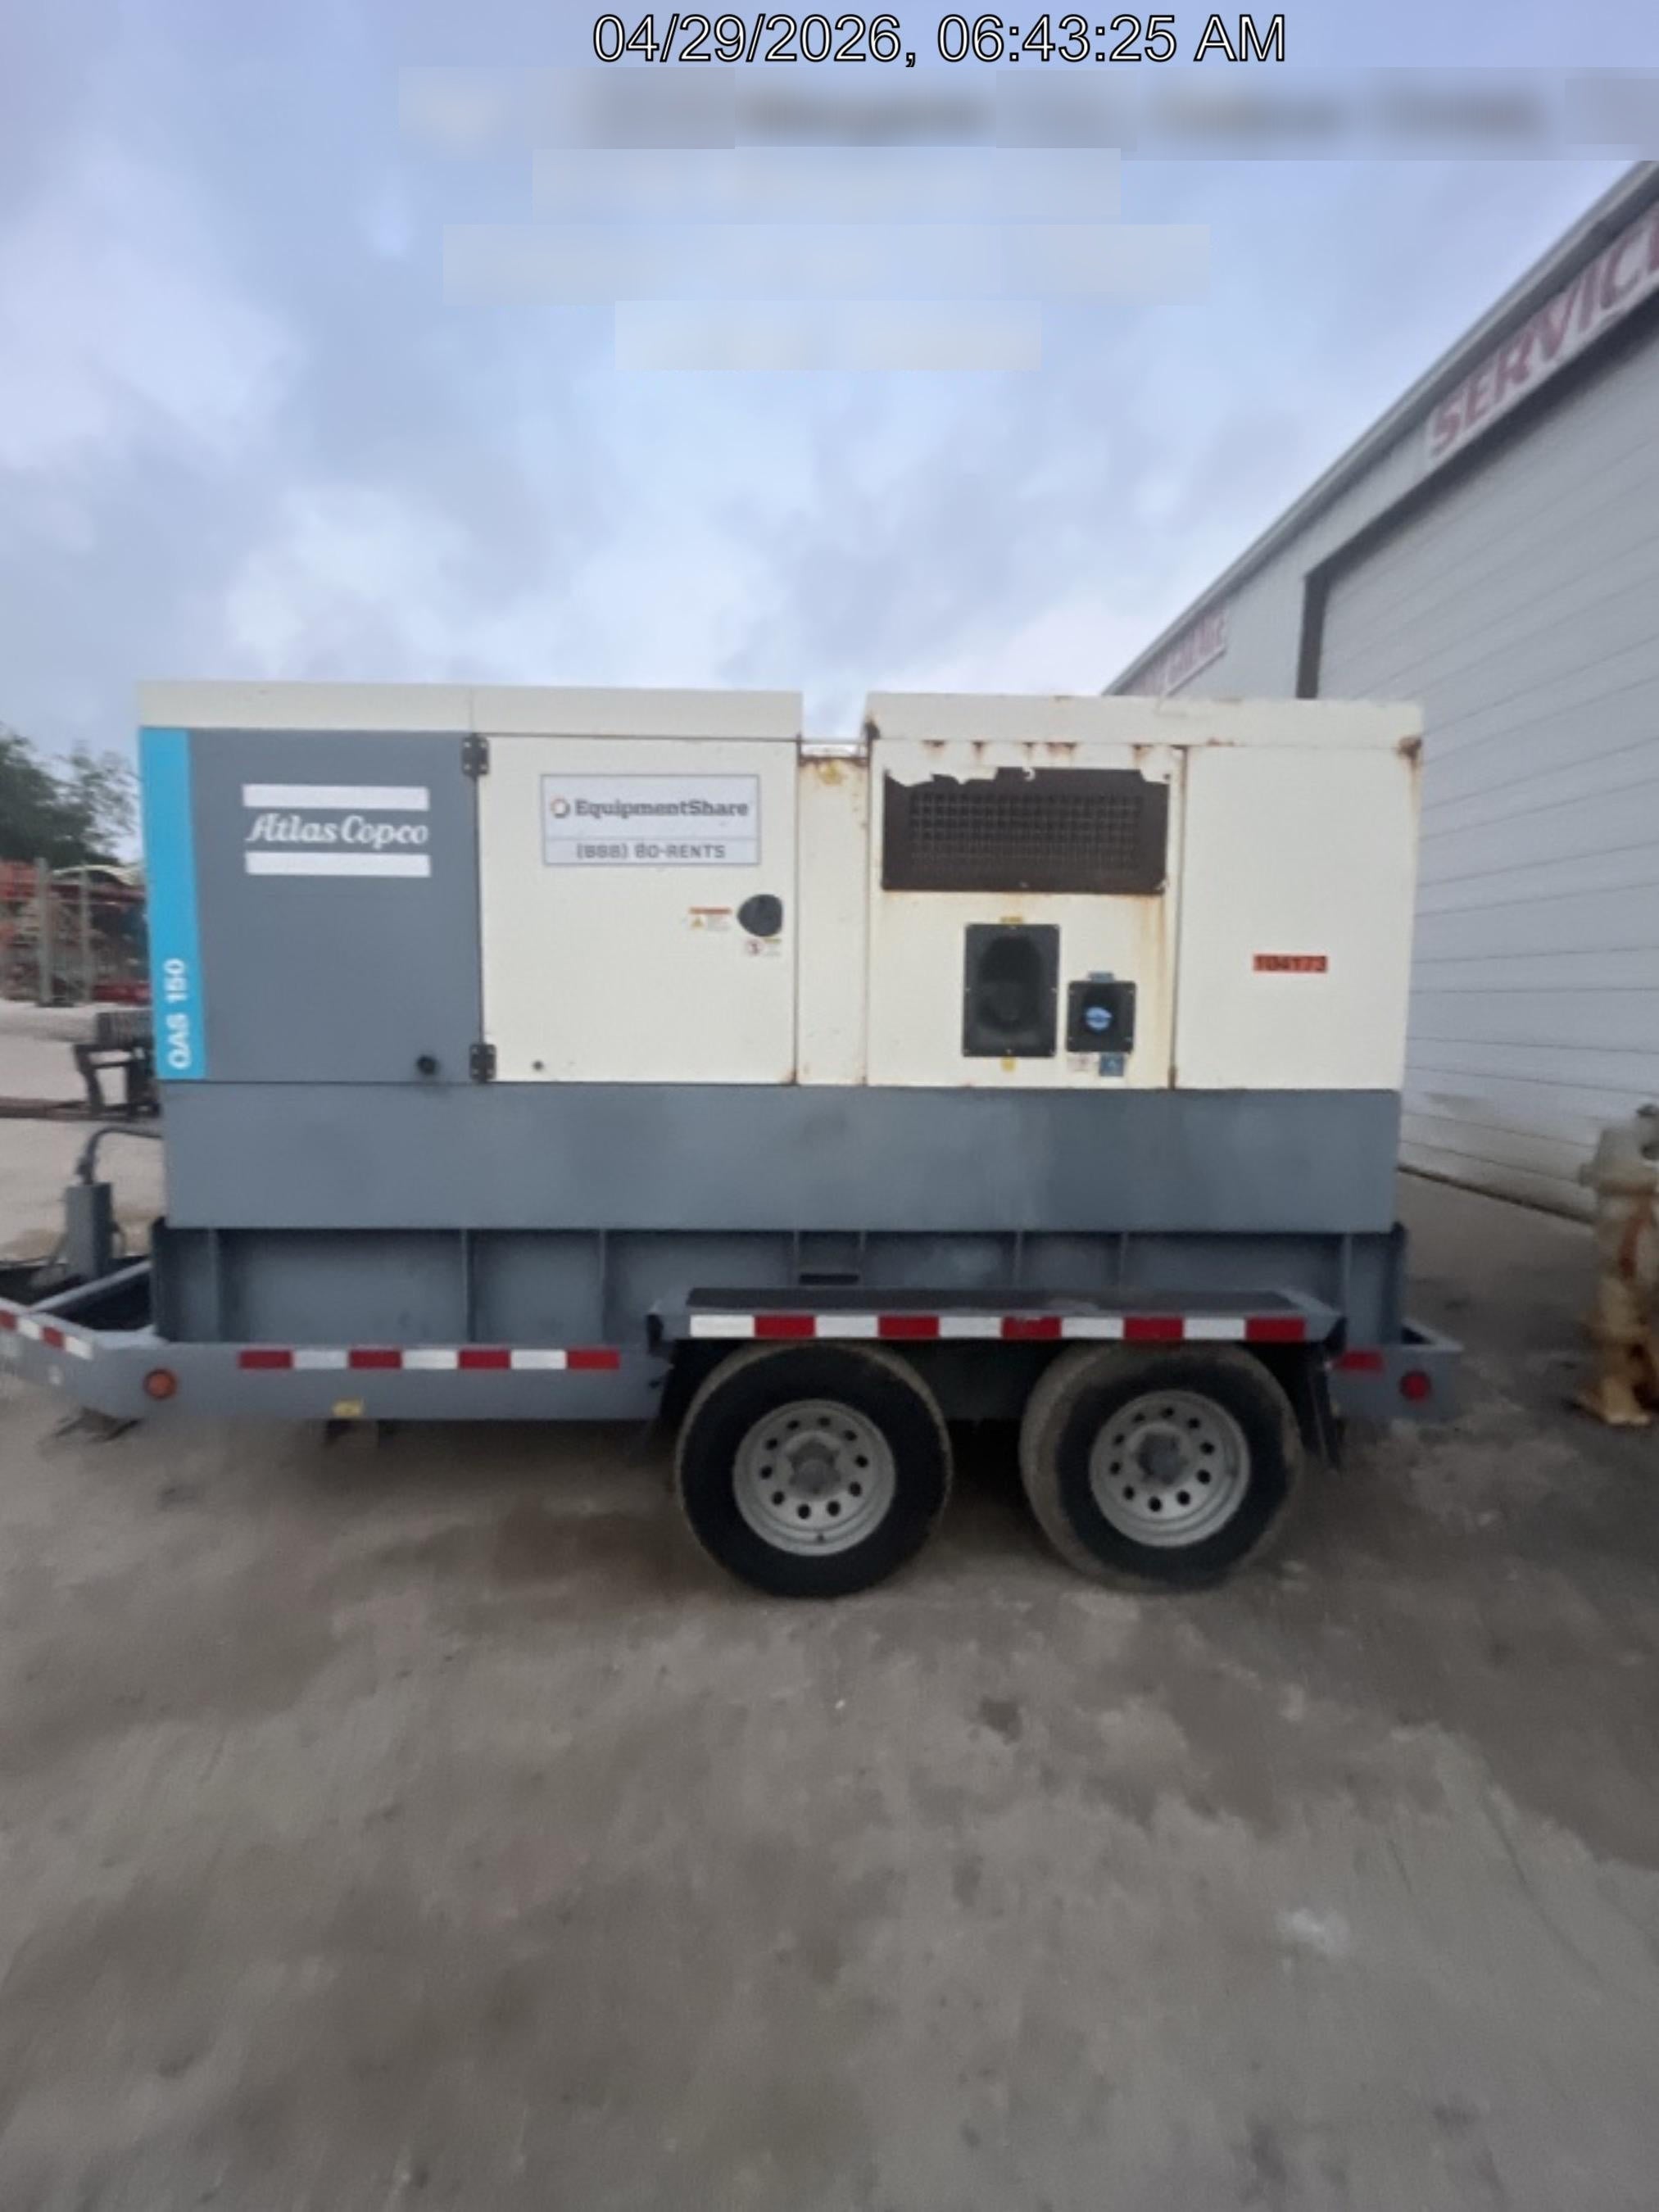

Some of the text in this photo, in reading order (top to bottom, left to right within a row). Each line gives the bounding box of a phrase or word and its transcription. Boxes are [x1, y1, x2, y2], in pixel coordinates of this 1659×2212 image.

[574, 798, 749, 819] EquipmentShare
[245, 813, 429, 850] Atlas Copco
[635, 842, 725, 859] 80-RENTS
